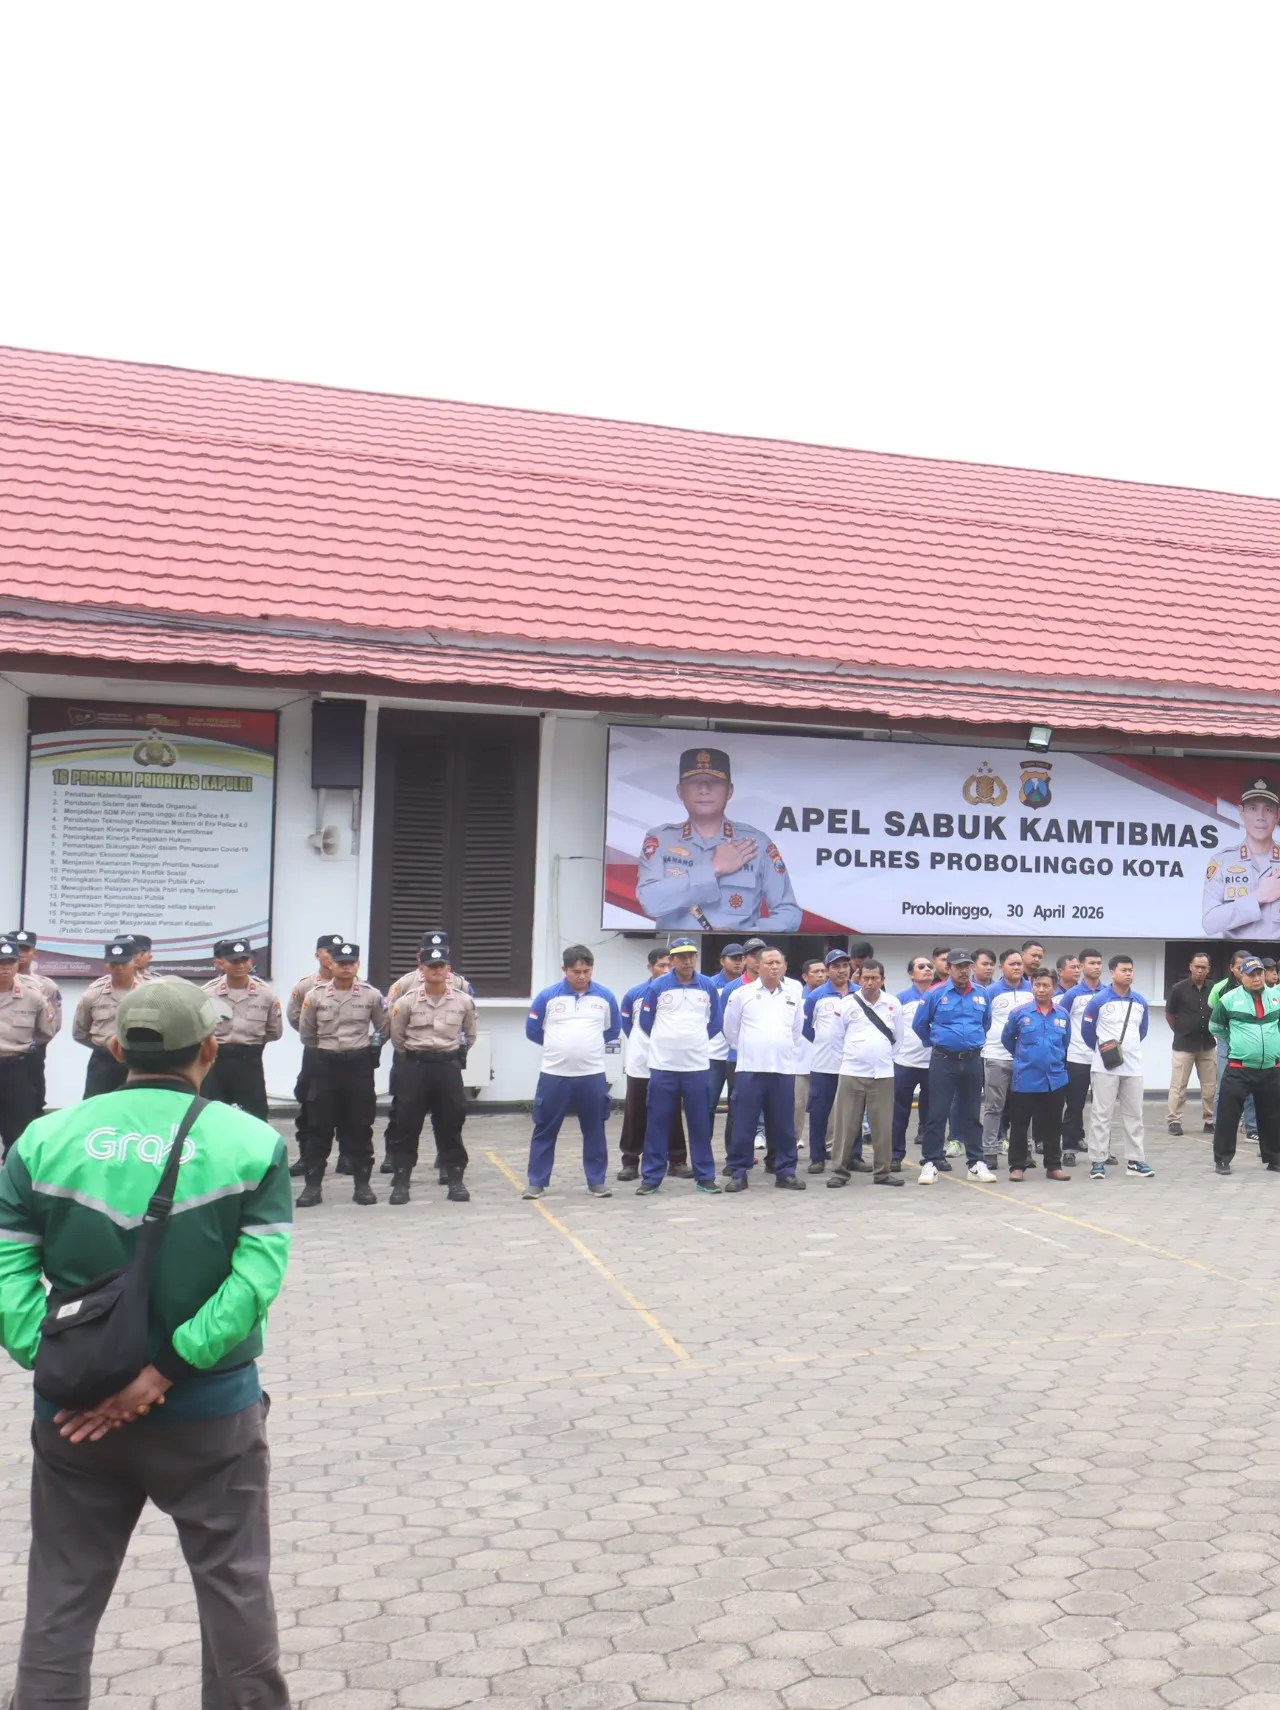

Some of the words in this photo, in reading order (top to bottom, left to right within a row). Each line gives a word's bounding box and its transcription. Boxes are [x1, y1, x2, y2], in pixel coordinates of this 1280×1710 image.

[52, 768, 68, 785] 16
[71, 770, 132, 787] PROGRAM
[135, 772, 199, 790] PRIORITAS
[202, 775, 252, 792] KAPOLRI
[774, 806, 870, 836] APEL
[884, 810, 1007, 841] SABUK
[1019, 816, 1219, 848] KAMTIBMAS
[816, 848, 920, 870] POLRES
[930, 852, 1114, 876] PROBOLINGGO
[1122, 858, 1184, 878] KOTA
[902, 901, 992, 920] Probolinggo,
[1006, 904, 1024, 918] 30
[1033, 904, 1065, 922] April
[1072, 906, 1104, 919] 2026
